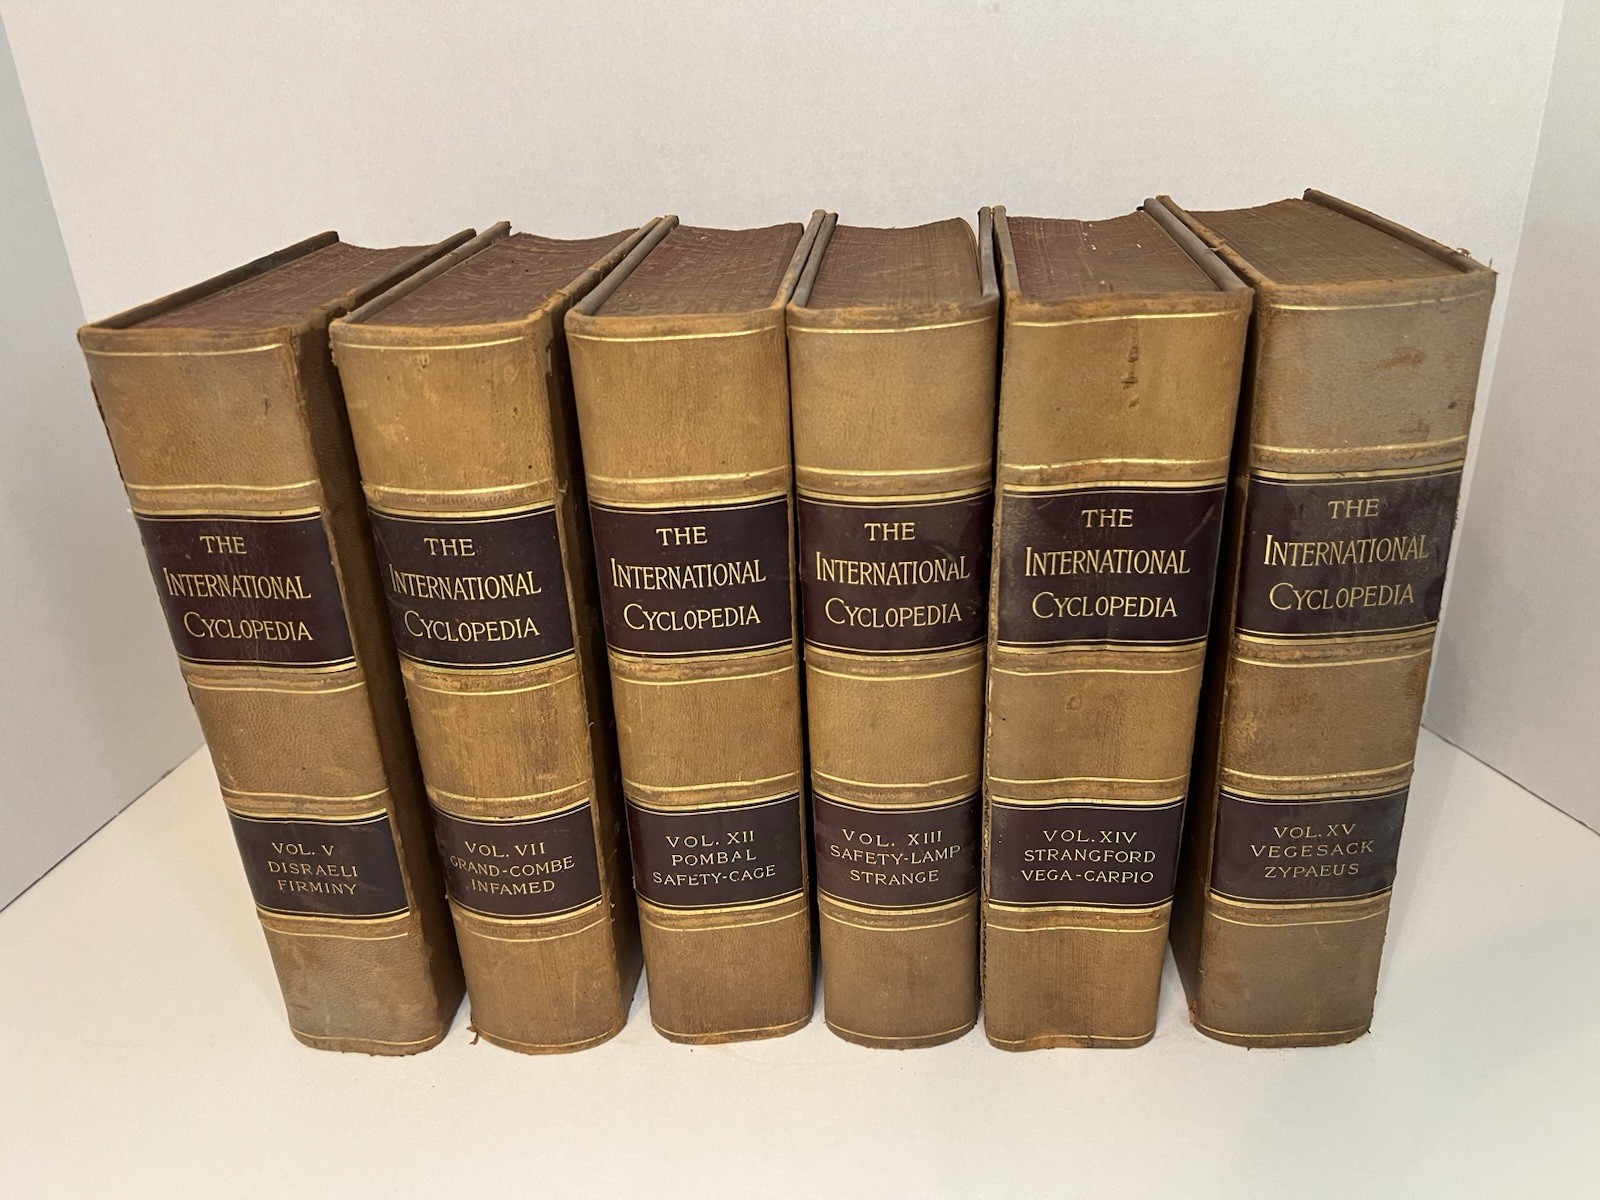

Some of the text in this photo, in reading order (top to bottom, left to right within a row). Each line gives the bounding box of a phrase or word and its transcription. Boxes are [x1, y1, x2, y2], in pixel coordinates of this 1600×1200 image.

[1082, 508, 1134, 528] THE
[1327, 498, 1379, 520] THE
[656, 526, 708, 546] THE
[864, 522, 915, 542] THE
[200, 535, 247, 555] THE
[424, 537, 476, 557] THE
[1263, 534, 1429, 567] INTERNATIONAL
[816, 551, 970, 586] INTERNATIONAL
[1025, 546, 1191, 577] INTERNATIONAL
[163, 567, 312, 600] INTERNATIONAL
[389, 564, 542, 600] INTERNATIONAL
[610, 557, 767, 590] INTERNATIONAL
[1031, 591, 1177, 619] CYCLOPEDIA
[1269, 582, 1414, 612] CYCLOPEDIA
[623, 603, 761, 631] CYCLOPEDIA
[825, 597, 962, 628] CYCLOPEDIA
[183, 611, 314, 642] CYCLOPEDIA
[404, 610, 540, 643] CYCLOPEDIA
[666, 830, 755, 848] VOL. XII
[842, 828, 942, 847] VOL. XIII
[1043, 829, 1138, 844] VOL. XIV
[1273, 823, 1356, 840] VOL. XV
[271, 842, 334, 857] VOL. V
[464, 841, 546, 858] VOL. VII
[671, 849, 757, 866] POMBAL
[830, 844, 961, 865] SAFETY-LAMP
[1024, 848, 1156, 864] STRANGFORD
[1250, 839, 1375, 859] VEGESACK
[267, 860, 358, 878] DISRAELI
[450, 855, 576, 878] GRAND-COMBE
[652, 865, 776, 886] SAFETY-CAGE
[1264, 863, 1360, 880] ZYPAEUS
[471, 878, 555, 896] INFAMED
[850, 869, 940, 886] STRANGE
[1021, 869, 1154, 885] VEGA-CARPIO
[277, 879, 357, 896] FIRMINY
